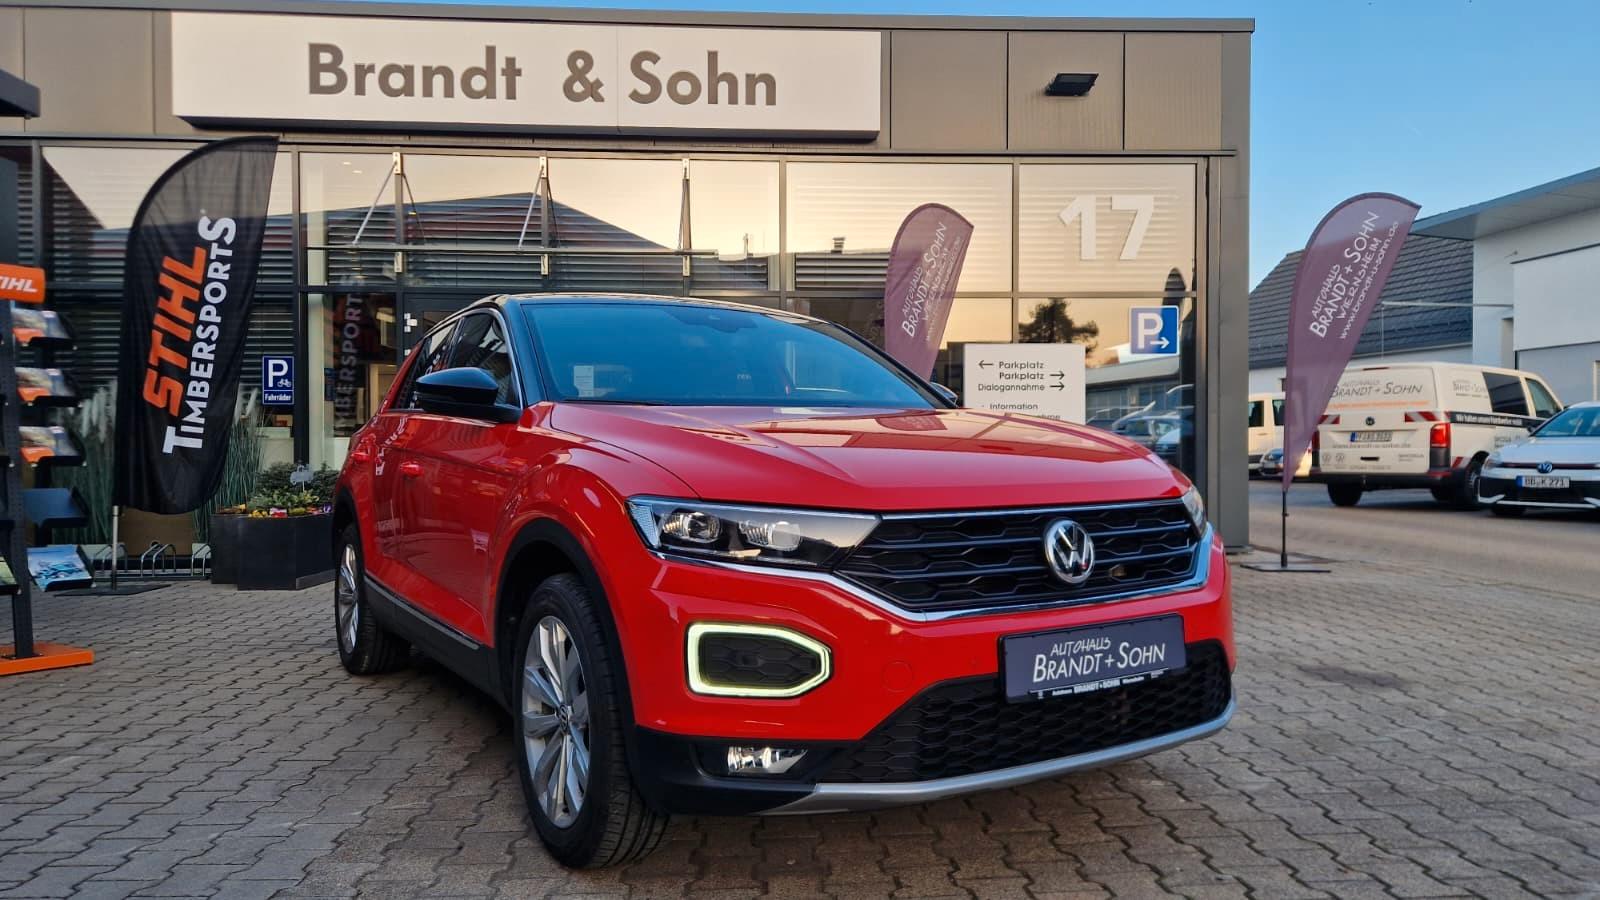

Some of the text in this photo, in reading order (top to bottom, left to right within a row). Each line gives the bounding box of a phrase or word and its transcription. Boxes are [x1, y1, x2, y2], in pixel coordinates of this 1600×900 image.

[308, 42, 778, 106] Brandt & Sohn
[1057, 194, 1155, 261] 17
[0, 275, 38, 293] TIHL
[901, 279, 931, 338] BRANDT
[923, 222, 948, 270] SOHN
[1309, 211, 1380, 338] BRANDT + SOHN
[1311, 264, 1341, 318] AUTOHAUS
[1336, 237, 1382, 319] WIERNSHEIM
[142, 246, 207, 417] STIHL
[162, 215, 237, 454] TIMBERSPORTS
[1137, 312, 1164, 349] P
[268, 359, 289, 388] P
[998, 361, 1045, 370] Parkplatz
[999, 372, 1045, 380] Parkplatz
[978, 383, 1045, 392] Dialogannahme
[989, 400, 1039, 410] Information
[1383, 381, 1424, 395] SOHN
[1032, 642, 1166, 683] BRANDT + SOHN
[1050, 637, 1112, 657] AUTOHAUS
